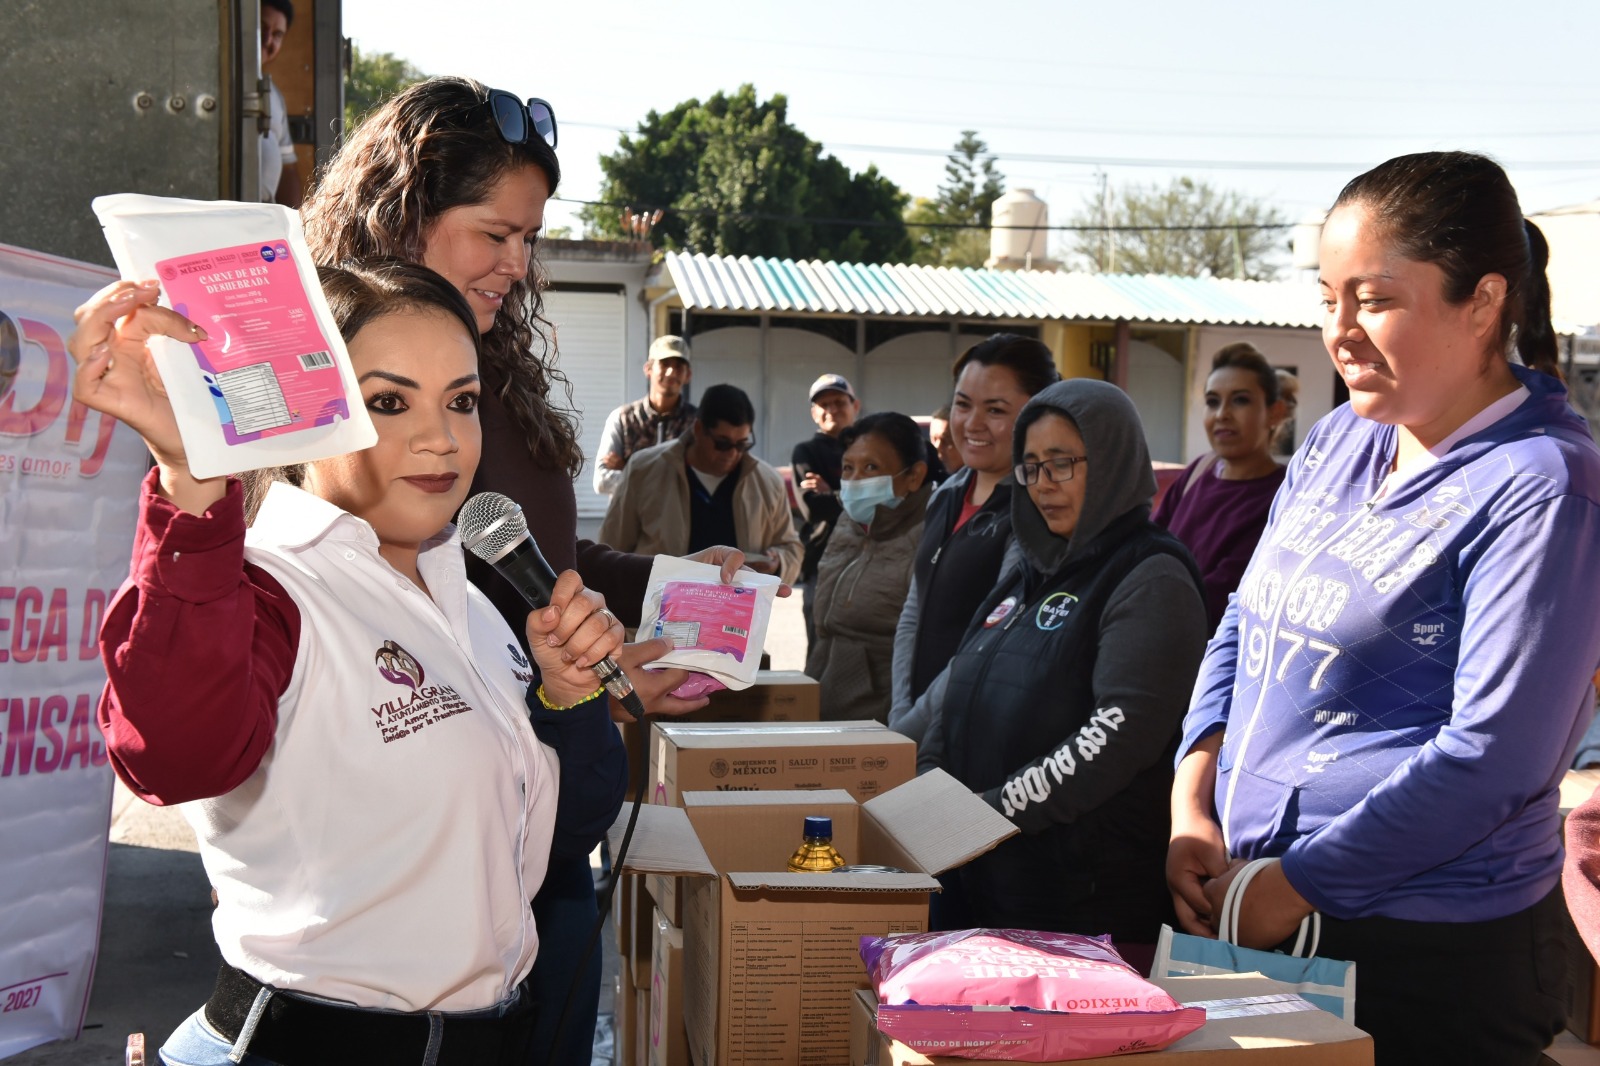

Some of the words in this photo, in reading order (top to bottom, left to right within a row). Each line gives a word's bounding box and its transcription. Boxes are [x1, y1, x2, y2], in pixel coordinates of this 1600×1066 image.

[215, 253, 236, 262] SALUD
[180, 263, 212, 276] MÉXICO
[199, 270, 233, 285] CARNE
[236, 268, 247, 277] DE
[250, 265, 268, 275] RES
[206, 276, 270, 294] DESHEBRADA
[22, 456, 71, 476] amor
[1413, 622, 1445, 634] Sport
[1238, 616, 1340, 691] 1977
[371, 684, 456, 718] VILLAGRÁN
[388, 698, 440, 724] AYUNTAMIENTO
[1314, 709, 1359, 726] HOLLIDAY
[382, 725, 398, 736] Por
[404, 711, 428, 727] Amor
[412, 721, 424, 733] por
[1076, 706, 1125, 761] SLAY
[788, 758, 818, 767] SALUD
[829, 757, 856, 766] SNDIF
[1307, 751, 1339, 763] Sport
[732, 765, 777, 776] MÉXICO
[961, 964, 1081, 979] LECHE
[3, 985, 42, 1013] 2027
[1067, 997, 1139, 1011] MÉXICO
[908, 1039, 945, 1047] LISTADO
